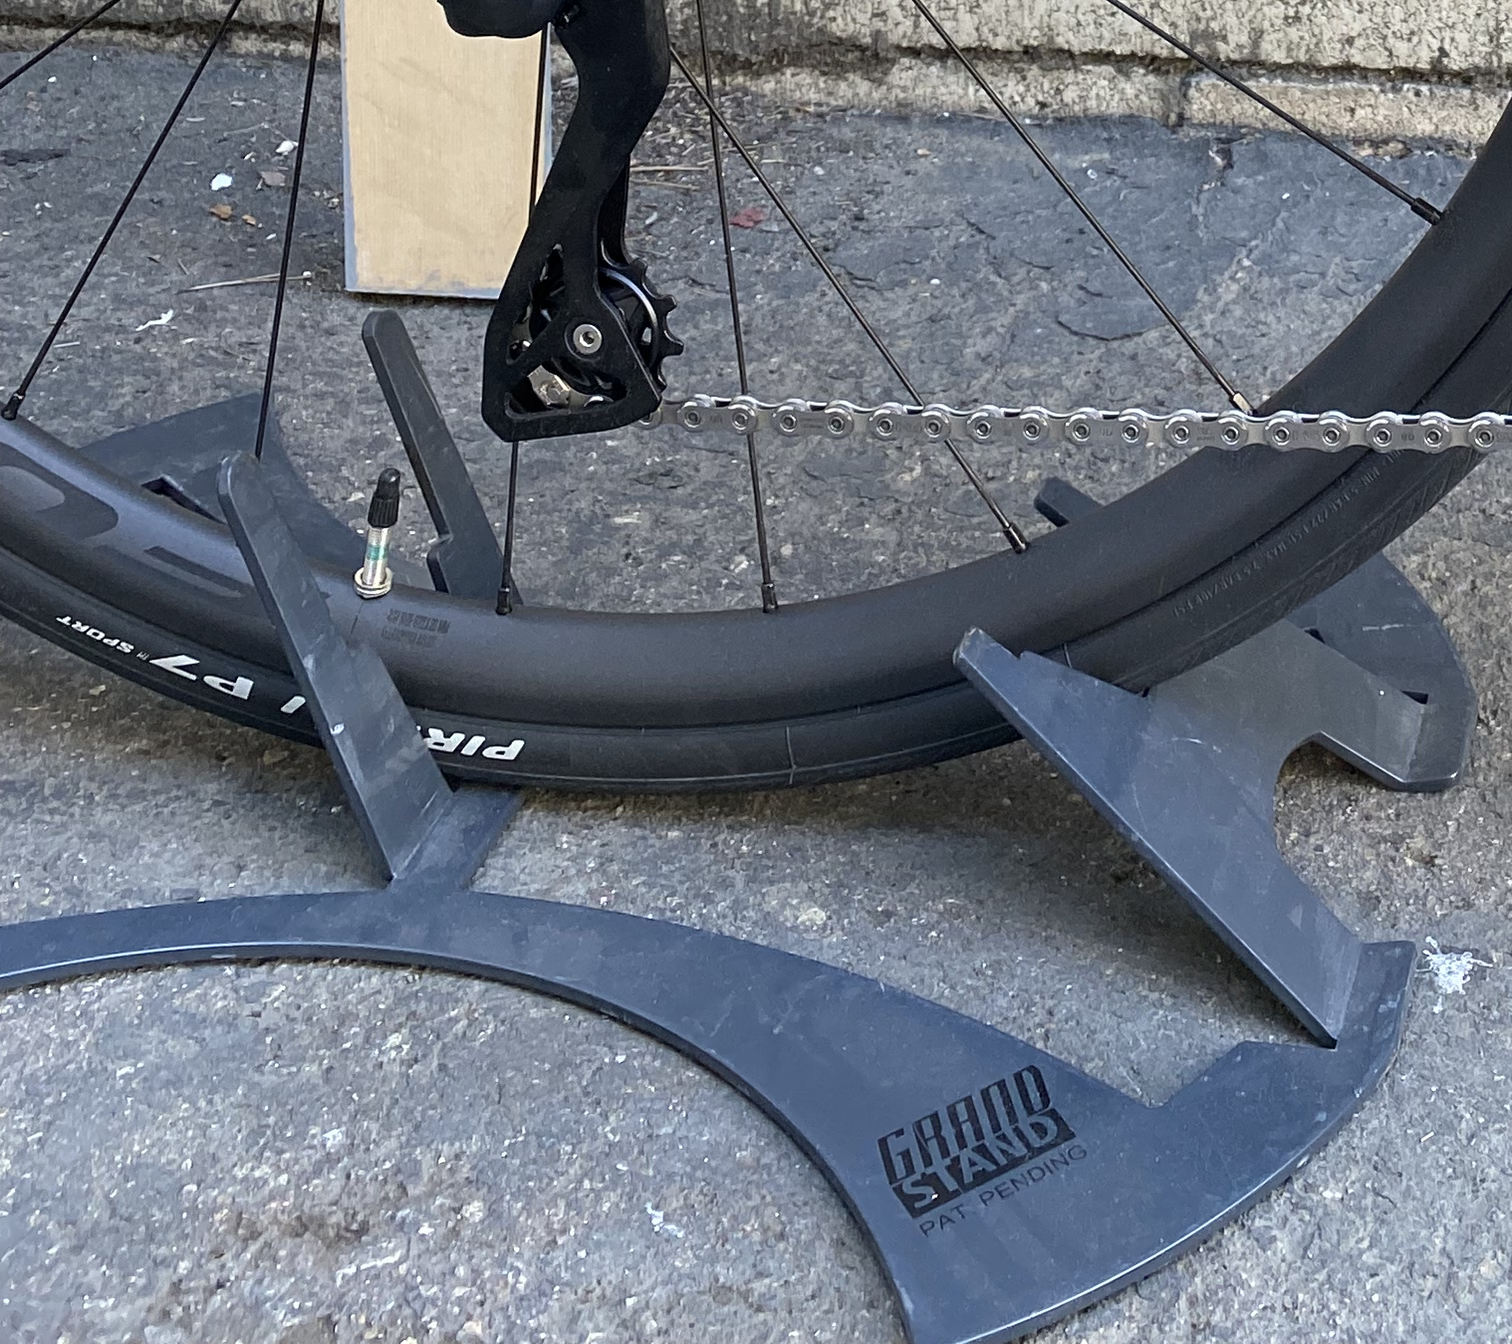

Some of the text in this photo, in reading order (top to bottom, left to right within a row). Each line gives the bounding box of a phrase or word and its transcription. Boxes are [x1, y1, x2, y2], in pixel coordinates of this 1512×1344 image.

[55, 615, 135, 654] SPORT
[877, 1064, 1051, 1186] GRAND
[902, 1114, 1058, 1209] STAND
[918, 1144, 1088, 1238] PAT PENDING
